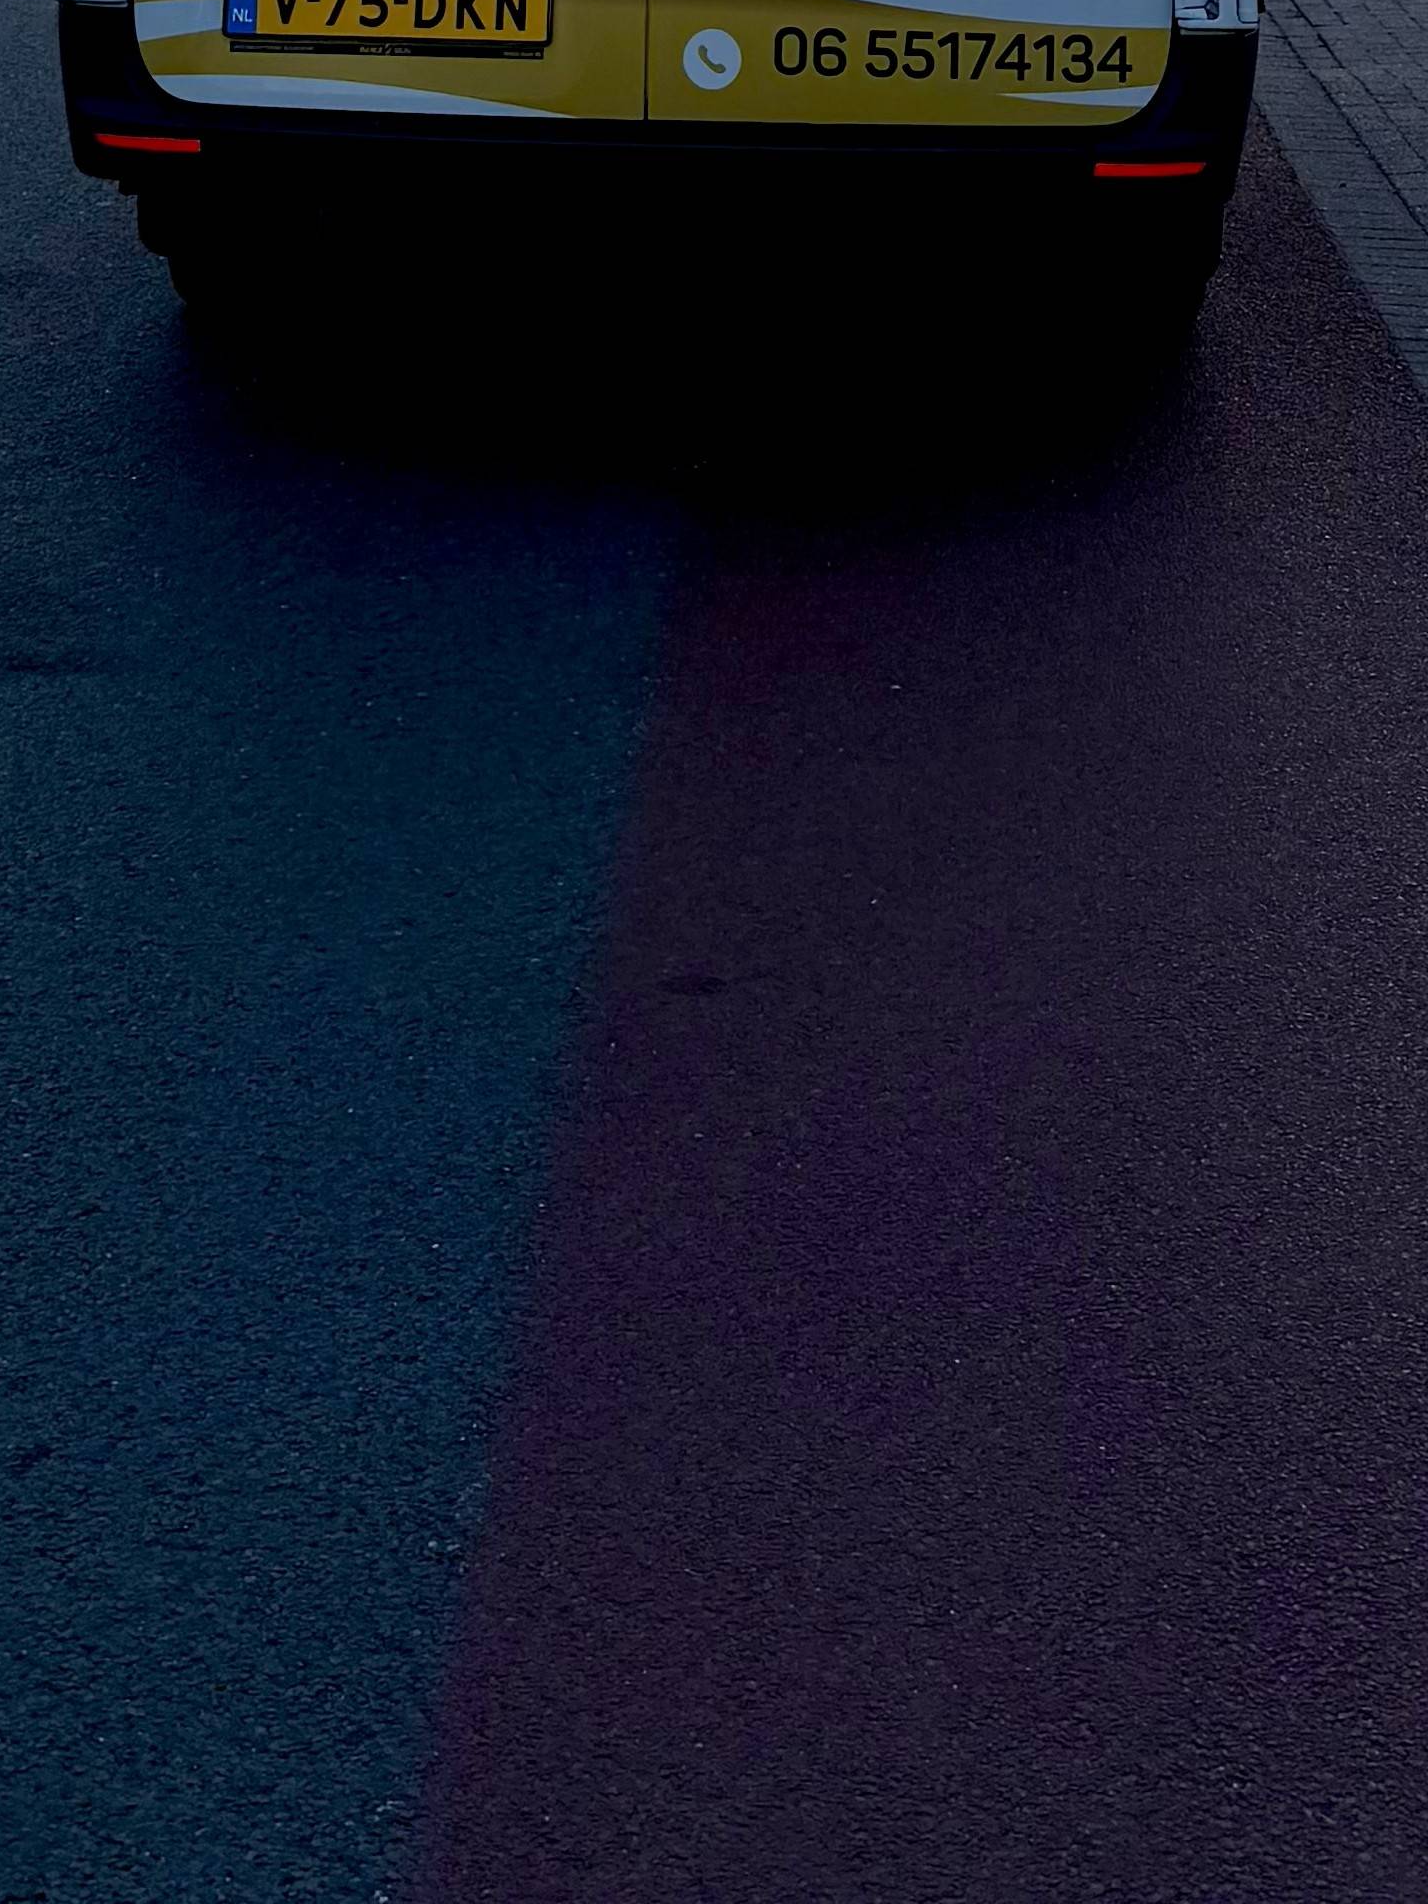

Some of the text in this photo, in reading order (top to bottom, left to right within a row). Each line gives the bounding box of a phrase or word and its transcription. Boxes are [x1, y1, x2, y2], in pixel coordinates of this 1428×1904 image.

[232, 7, 253, 23] NL
[773, 26, 1134, 84] 06 55174134
